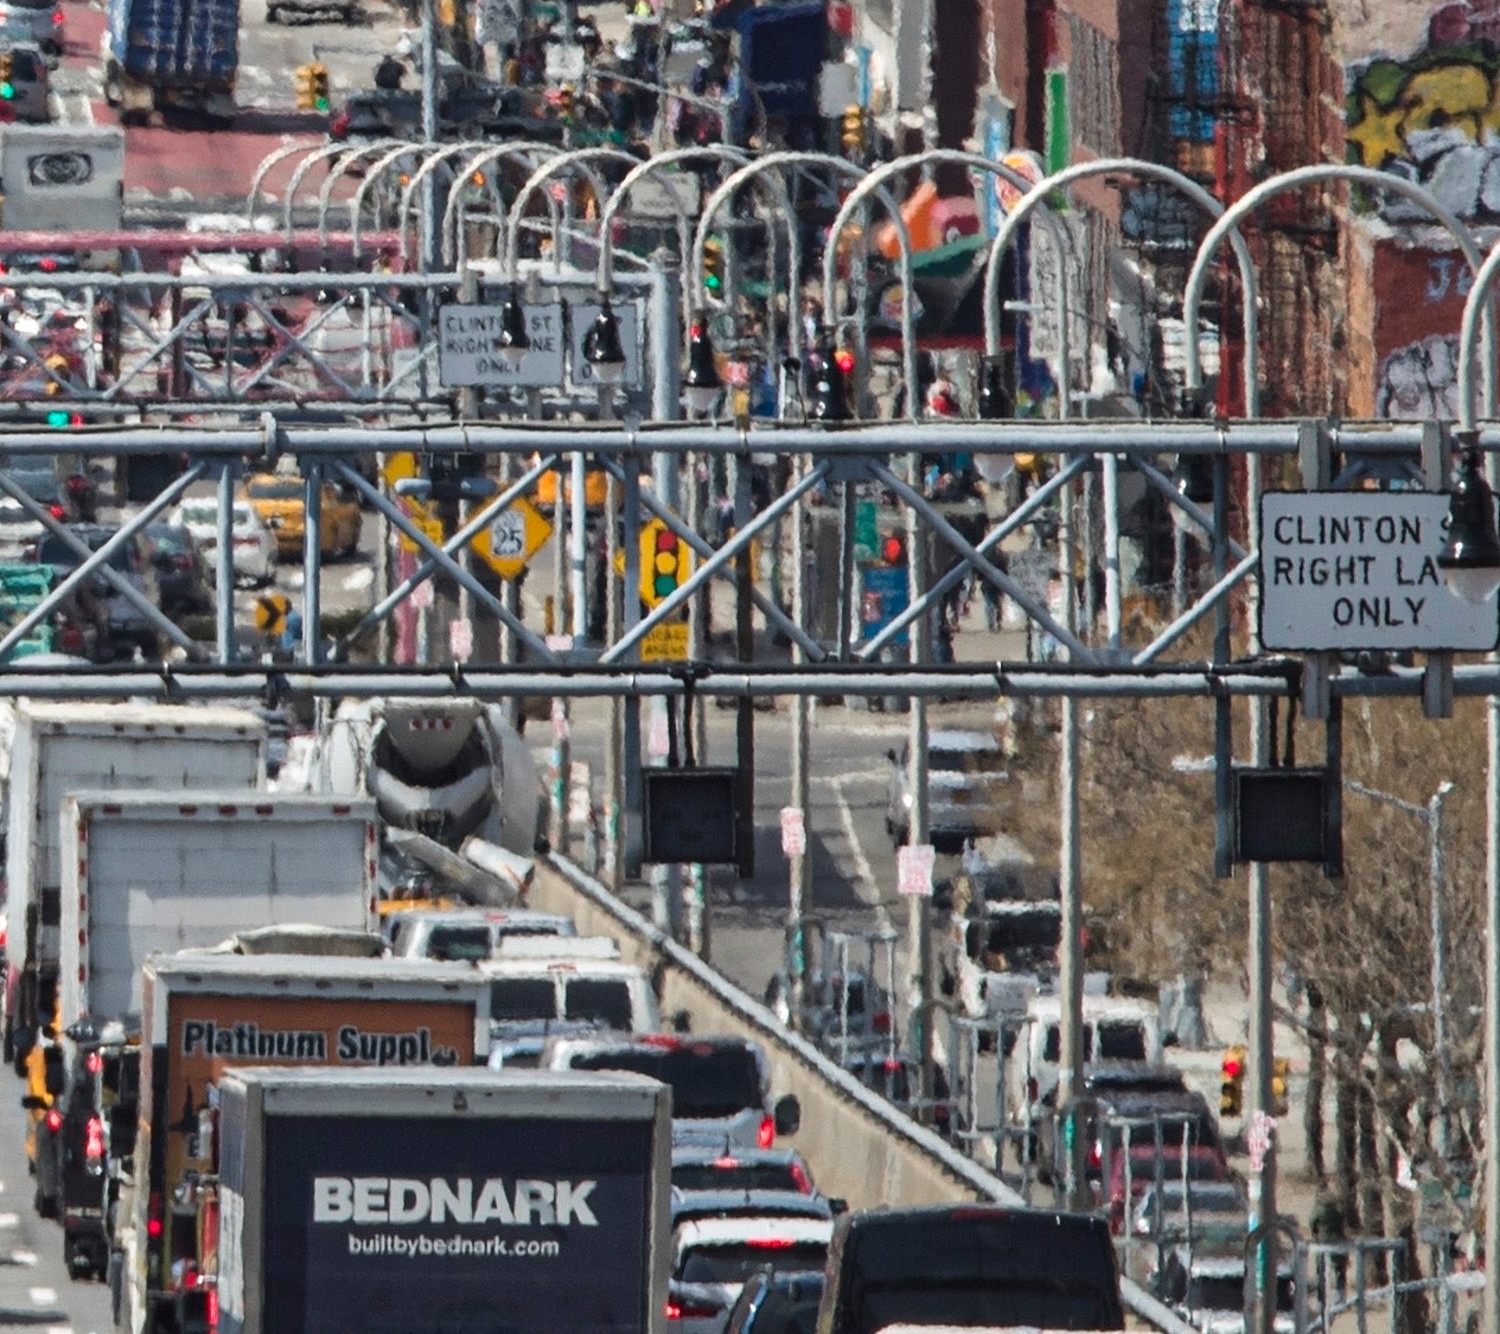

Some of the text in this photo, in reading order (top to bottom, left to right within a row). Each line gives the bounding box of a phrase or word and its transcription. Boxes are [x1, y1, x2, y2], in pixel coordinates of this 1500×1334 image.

[1274, 516, 1422, 544] CLINTON
[1274, 557, 1447, 586] RIGHT LA
[1333, 597, 1426, 627] ONLY
[182, 1020, 326, 1061] Platinum
[313, 1176, 599, 1226] BEDNARK
[349, 1233, 560, 1257] builtbybednark.com
